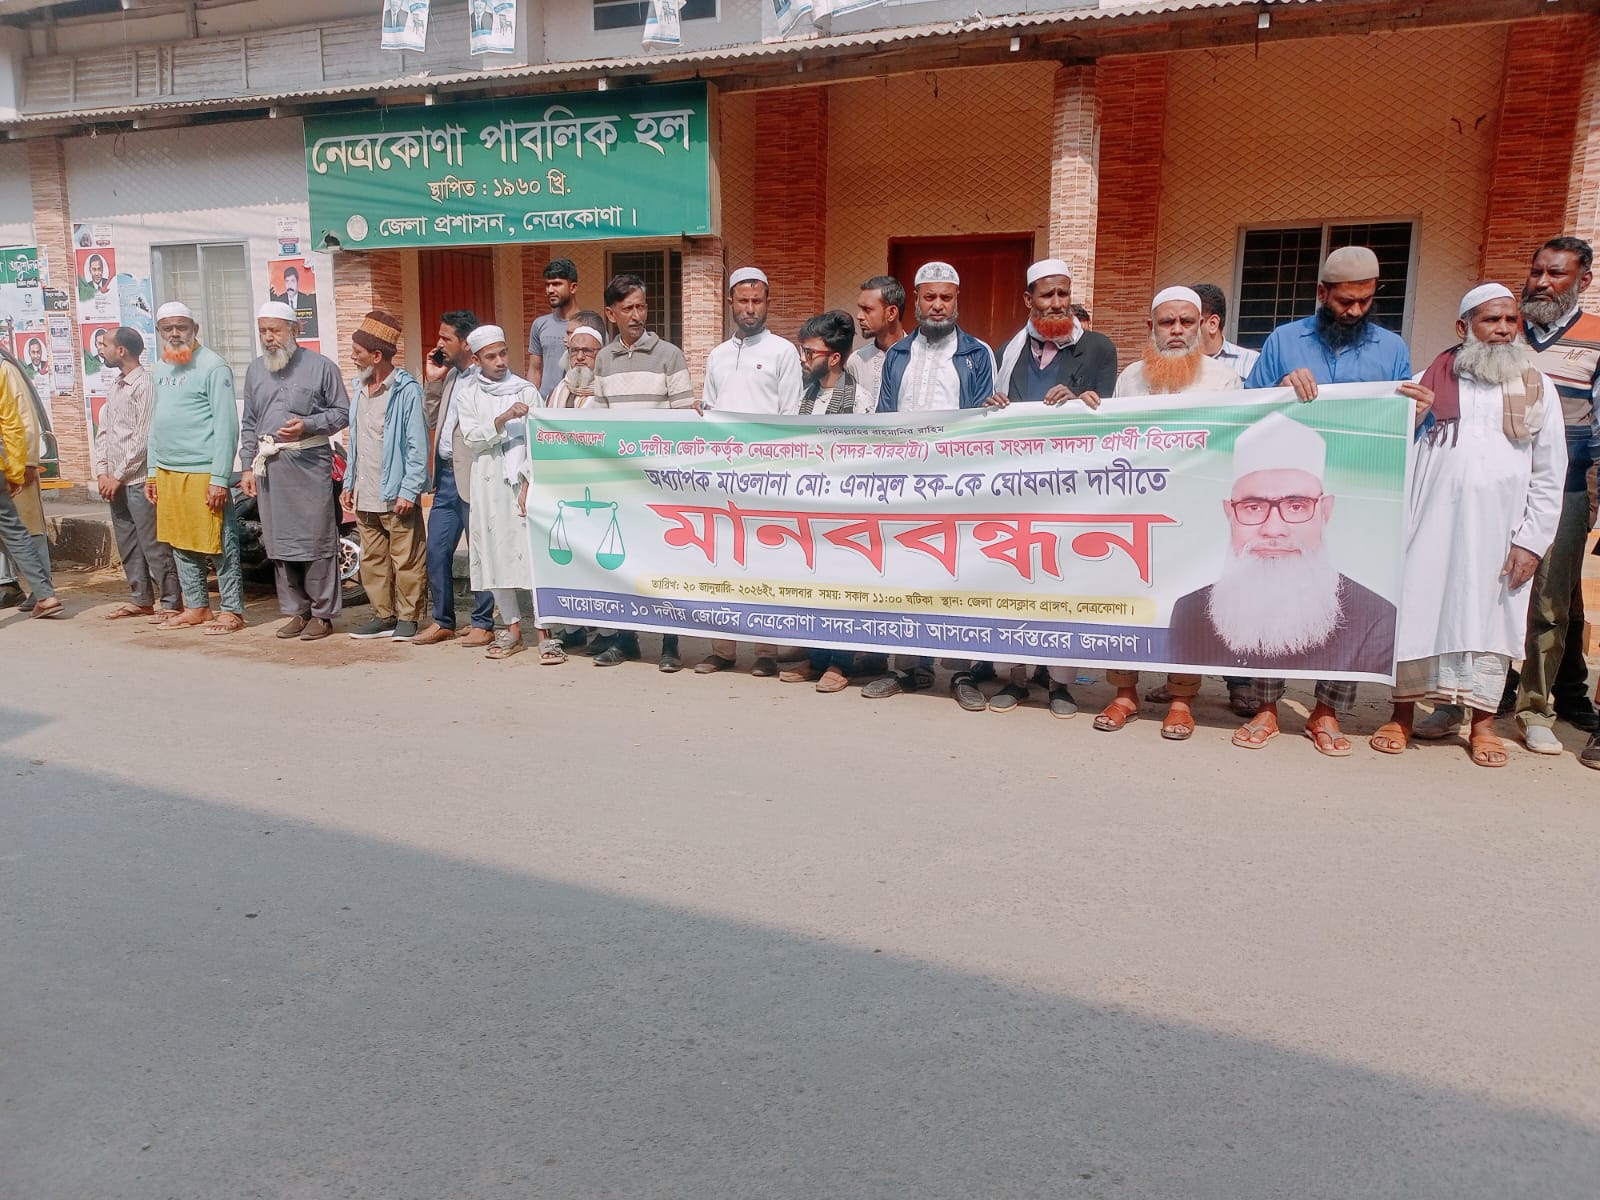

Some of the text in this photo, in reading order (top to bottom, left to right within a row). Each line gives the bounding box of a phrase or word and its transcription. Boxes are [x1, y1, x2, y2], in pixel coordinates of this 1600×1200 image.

[312, 105, 695, 175] নেত্রকোণা পাবলিক হল
[427, 175, 476, 203] স্থাপিত
[493, 178, 541, 197] ১৯৬০
[546, 168, 571, 196] খ্রি.
[379, 216, 428, 237] জেলা
[434, 213, 516, 237] প্রশাসন,
[619, 440, 635, 455] ১০
[641, 435, 673, 456] দলীয়
[677, 437, 706, 456] জোট
[710, 436, 743, 463] কর্তৃক
[935, 440, 995, 458] আসনের
[999, 438, 1046, 456] সংসদ
[1050, 436, 1097, 455] সদস্য
[1101, 427, 1142, 452] প্রার্থী
[1145, 428, 1209, 450] হিসেবে
[644, 468, 713, 493] অধ্যাপক
[717, 470, 791, 497] মাওলানা
[840, 472, 908, 504] এনামুল
[913, 473, 985, 501] হক-কে
[991, 468, 1078, 497] ঘোষনার
[1085, 457, 1171, 497] দাবীতে
[646, 501, 1179, 584] মানববন্ধন
[683, 581, 695, 592] ২০
[778, 586, 812, 599] মঙ্গলবার
[845, 590, 869, 603] সকাল
[873, 593, 902, 604] ১১:০০
[905, 592, 933, 606] ঘটিকা
[967, 597, 992, 609] জেলা
[996, 597, 1036, 611] প্রেসক্লাব
[631, 602, 649, 616] ১০
[651, 602, 687, 622] দলীয়
[691, 606, 742, 627] জোটের
[747, 611, 816, 633] নেত্রকোণা
[820, 615, 921, 639] সদর-বারহাট্টা
[925, 622, 992, 645] আসনের
[998, 622, 1074, 649] সর্বস্তরের
